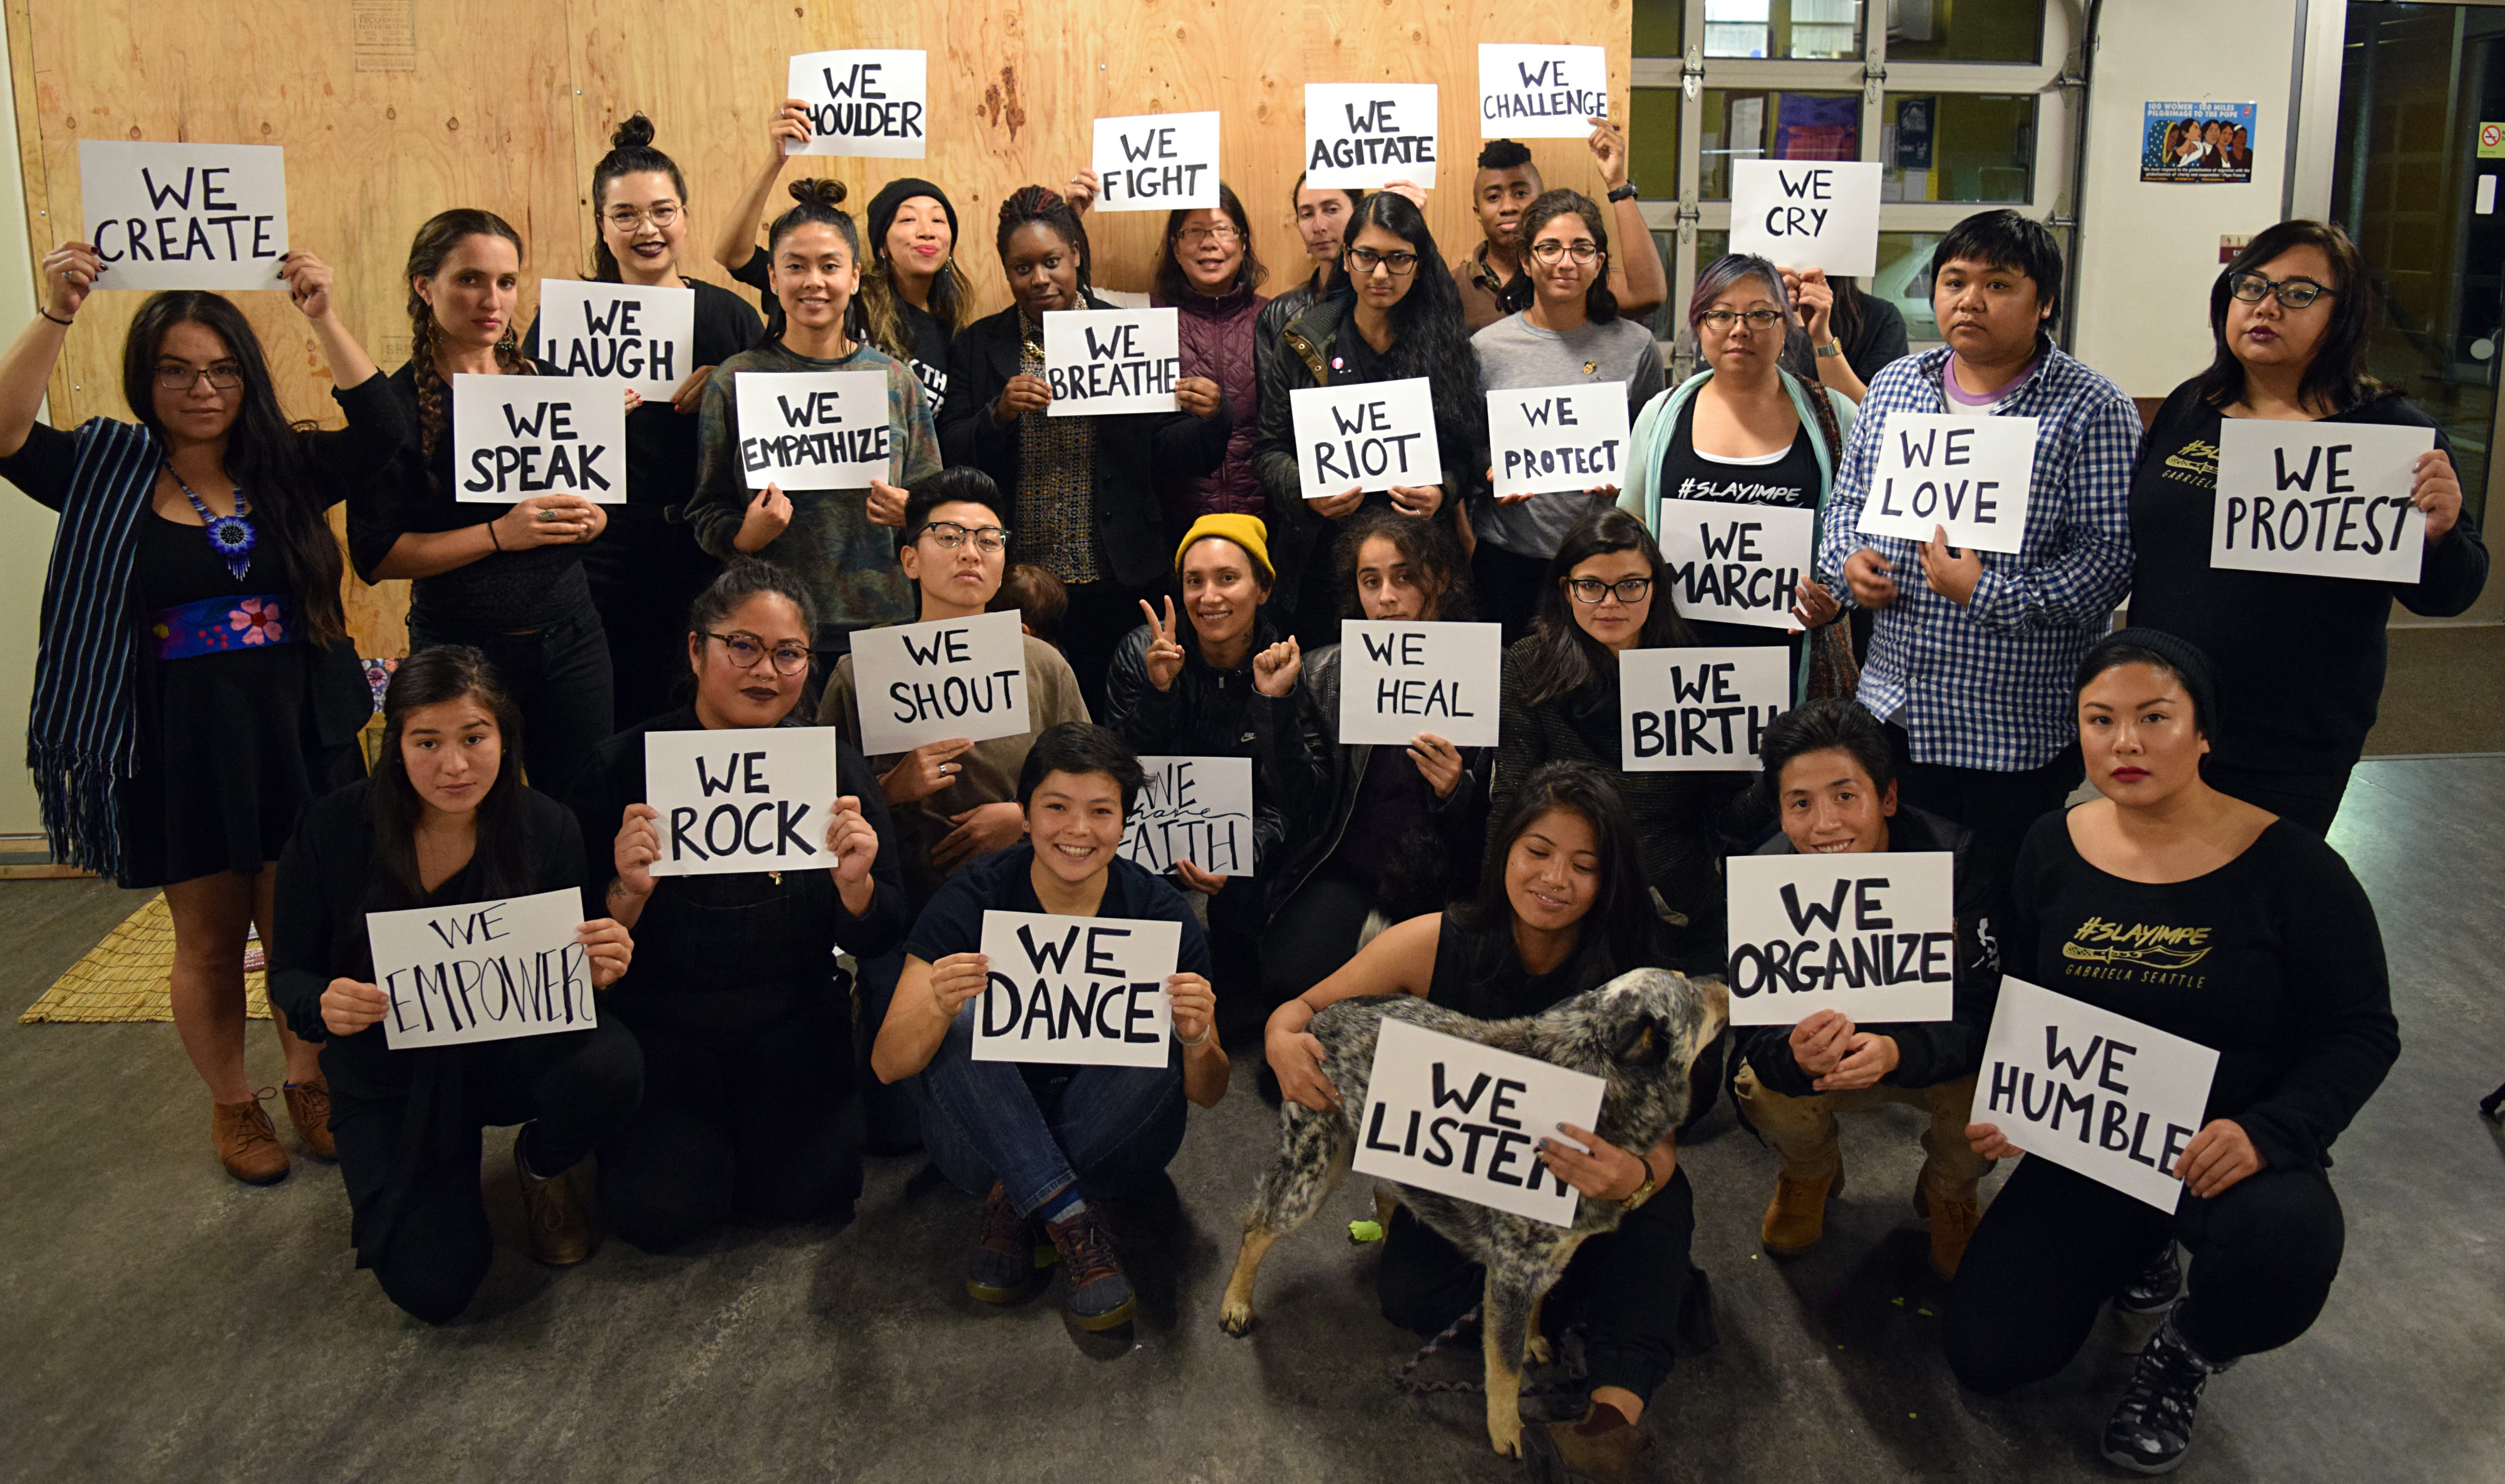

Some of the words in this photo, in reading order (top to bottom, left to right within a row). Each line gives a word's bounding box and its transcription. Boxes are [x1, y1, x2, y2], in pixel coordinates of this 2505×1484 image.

[823, 63, 886, 99] WE
[1519, 61, 1569, 88] WE
[788, 101, 922, 138] HOULDER
[1345, 101, 1400, 133] WE
[1484, 90, 1607, 120] CHALLENGE
[1120, 128, 1177, 162] WE
[1309, 135, 1435, 170] AGITATE
[142, 167, 237, 212] WE
[1103, 163, 1207, 201] FIGHT
[1779, 170, 1833, 200] WE
[95, 215, 277, 262] CREATE
[1766, 207, 1828, 238] CRY
[583, 300, 641, 337] WE
[1085, 324, 1145, 360] WE
[1048, 357, 1179, 401] BREATHE
[503, 402, 578, 441] WE
[777, 391, 842, 427] WE
[1331, 401, 1392, 436] WE
[1521, 397, 1578, 428] WE
[742, 425, 889, 473] EMPATHIZE
[1315, 432, 1420, 485] RIOT
[1505, 440, 1619, 480] PROTECT
[1900, 428, 1975, 468] WE
[2274, 444, 2355, 493] WE
[463, 445, 611, 493] SPEAK
[1678, 478, 1801, 502] #SLAYIMPE
[1881, 478, 1999, 524] LOVE
[1700, 522, 1762, 562] WE
[2226, 495, 2411, 555] PROTEST
[1666, 561, 1799, 614] MARCH
[902, 629, 971, 665] WE
[1362, 633, 1427, 667] WE
[890, 671, 1020, 723] SHOUT
[1376, 679, 1474, 718] HEAL
[1670, 662, 1741, 704] WE
[1633, 705, 1777, 758] BIRTH
[695, 751, 770, 797] WE
[1145, 761, 1197, 810] WE
[671, 801, 817, 862] ROCK
[428, 903, 510, 950] WE
[1780, 877, 1893, 936] WE
[1016, 925, 1132, 978] WE
[2074, 917, 2212, 949] #SLAYIMPE
[1728, 932, 1952, 998] ORGANIZE
[2065, 964, 2132, 981] GABRIELA
[2141, 971, 2206, 989] SEATTLE
[385, 941, 592, 1035] EMPOWER
[982, 972, 1160, 1044] DANCE
[2045, 1025, 2137, 1096] WE
[1432, 1063, 1527, 1130] WE
[1988, 1061, 2194, 1180] HUMBLE
